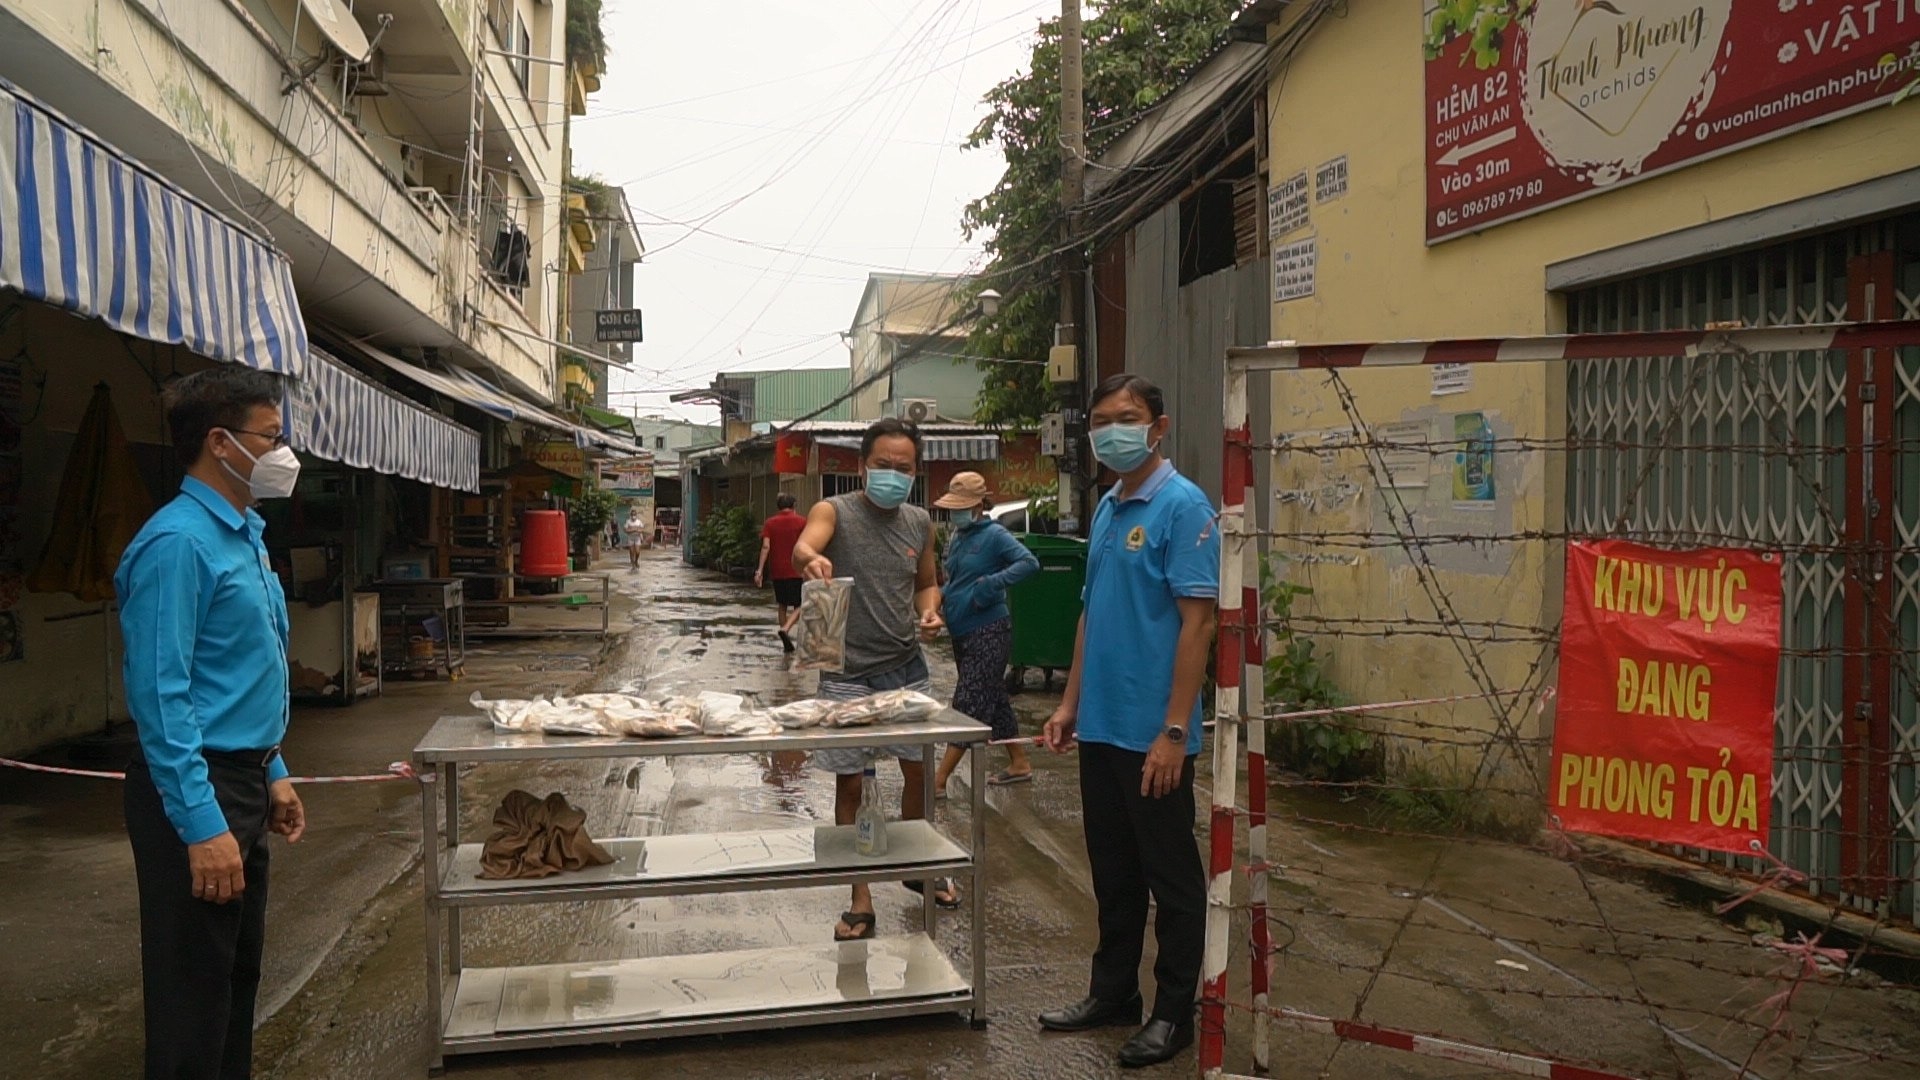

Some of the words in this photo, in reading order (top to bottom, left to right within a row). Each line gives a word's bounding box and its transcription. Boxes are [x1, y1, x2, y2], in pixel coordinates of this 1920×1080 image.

[1804, 0, 1881, 55] VẬT
[1534, 38, 1599, 100] Thanh
[1579, 66, 1656, 109] orchids
[1436, 84, 1479, 125] HẺM
[1483, 71, 1509, 103] 82
[1435, 126, 1460, 148] CHU
[1462, 113, 1489, 136] VĂN
[1491, 104, 1510, 126] AN
[1441, 172, 1472, 195] Vào
[1475, 157, 1510, 182] 30m
[1462, 191, 1506, 218] 096789
[1508, 184, 1524, 202] 79
[1526, 178, 1543, 198] 80
[1593, 555, 1664, 617] KHU
[1675, 557, 1747, 633] VỰC
[1616, 657, 1712, 721] ĐANG
[1558, 753, 1675, 820] PHONG
[1687, 747, 1758, 831] TỎA
